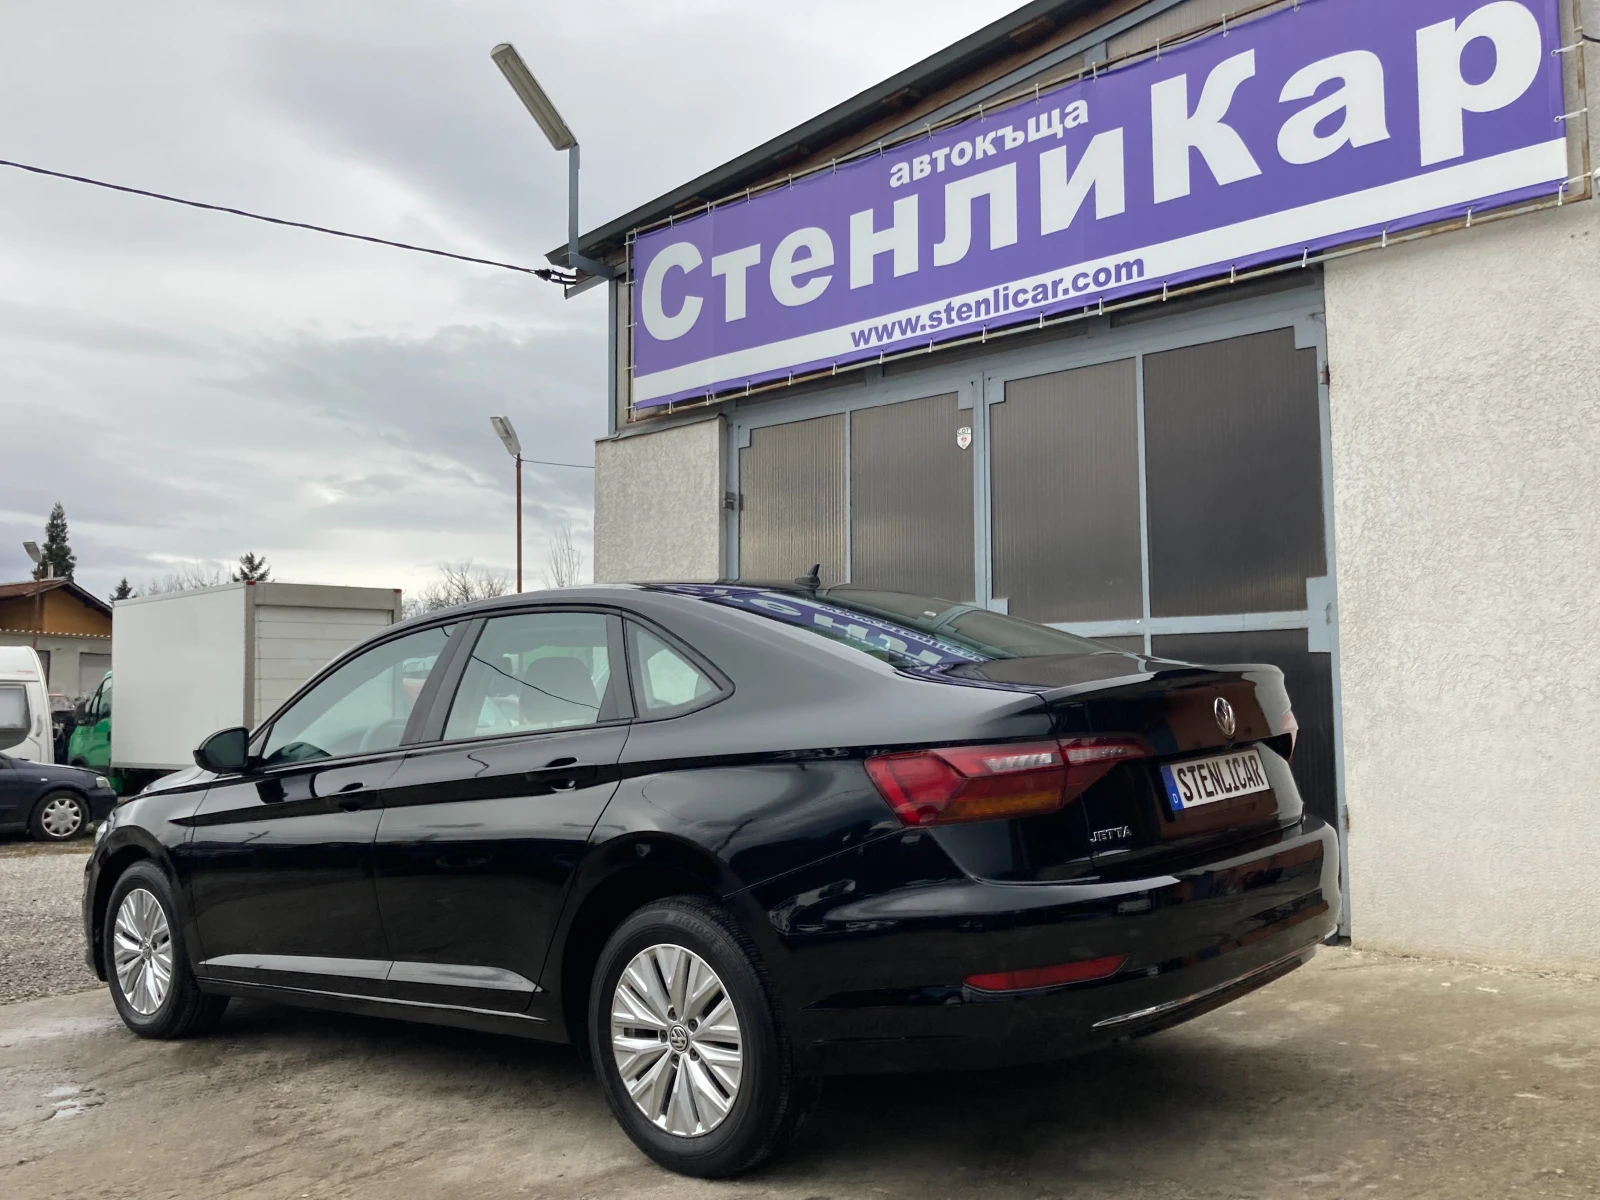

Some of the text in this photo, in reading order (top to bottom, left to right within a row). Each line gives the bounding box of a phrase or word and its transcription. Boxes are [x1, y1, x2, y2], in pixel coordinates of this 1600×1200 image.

[641, 1, 1542, 341] СтенлиКар
[889, 100, 1089, 188] автокъща
[850, 256, 1145, 347] www.stenlicar.com
[1177, 755, 1265, 802] STENLICAR
[1089, 825, 1132, 842] JETTA
